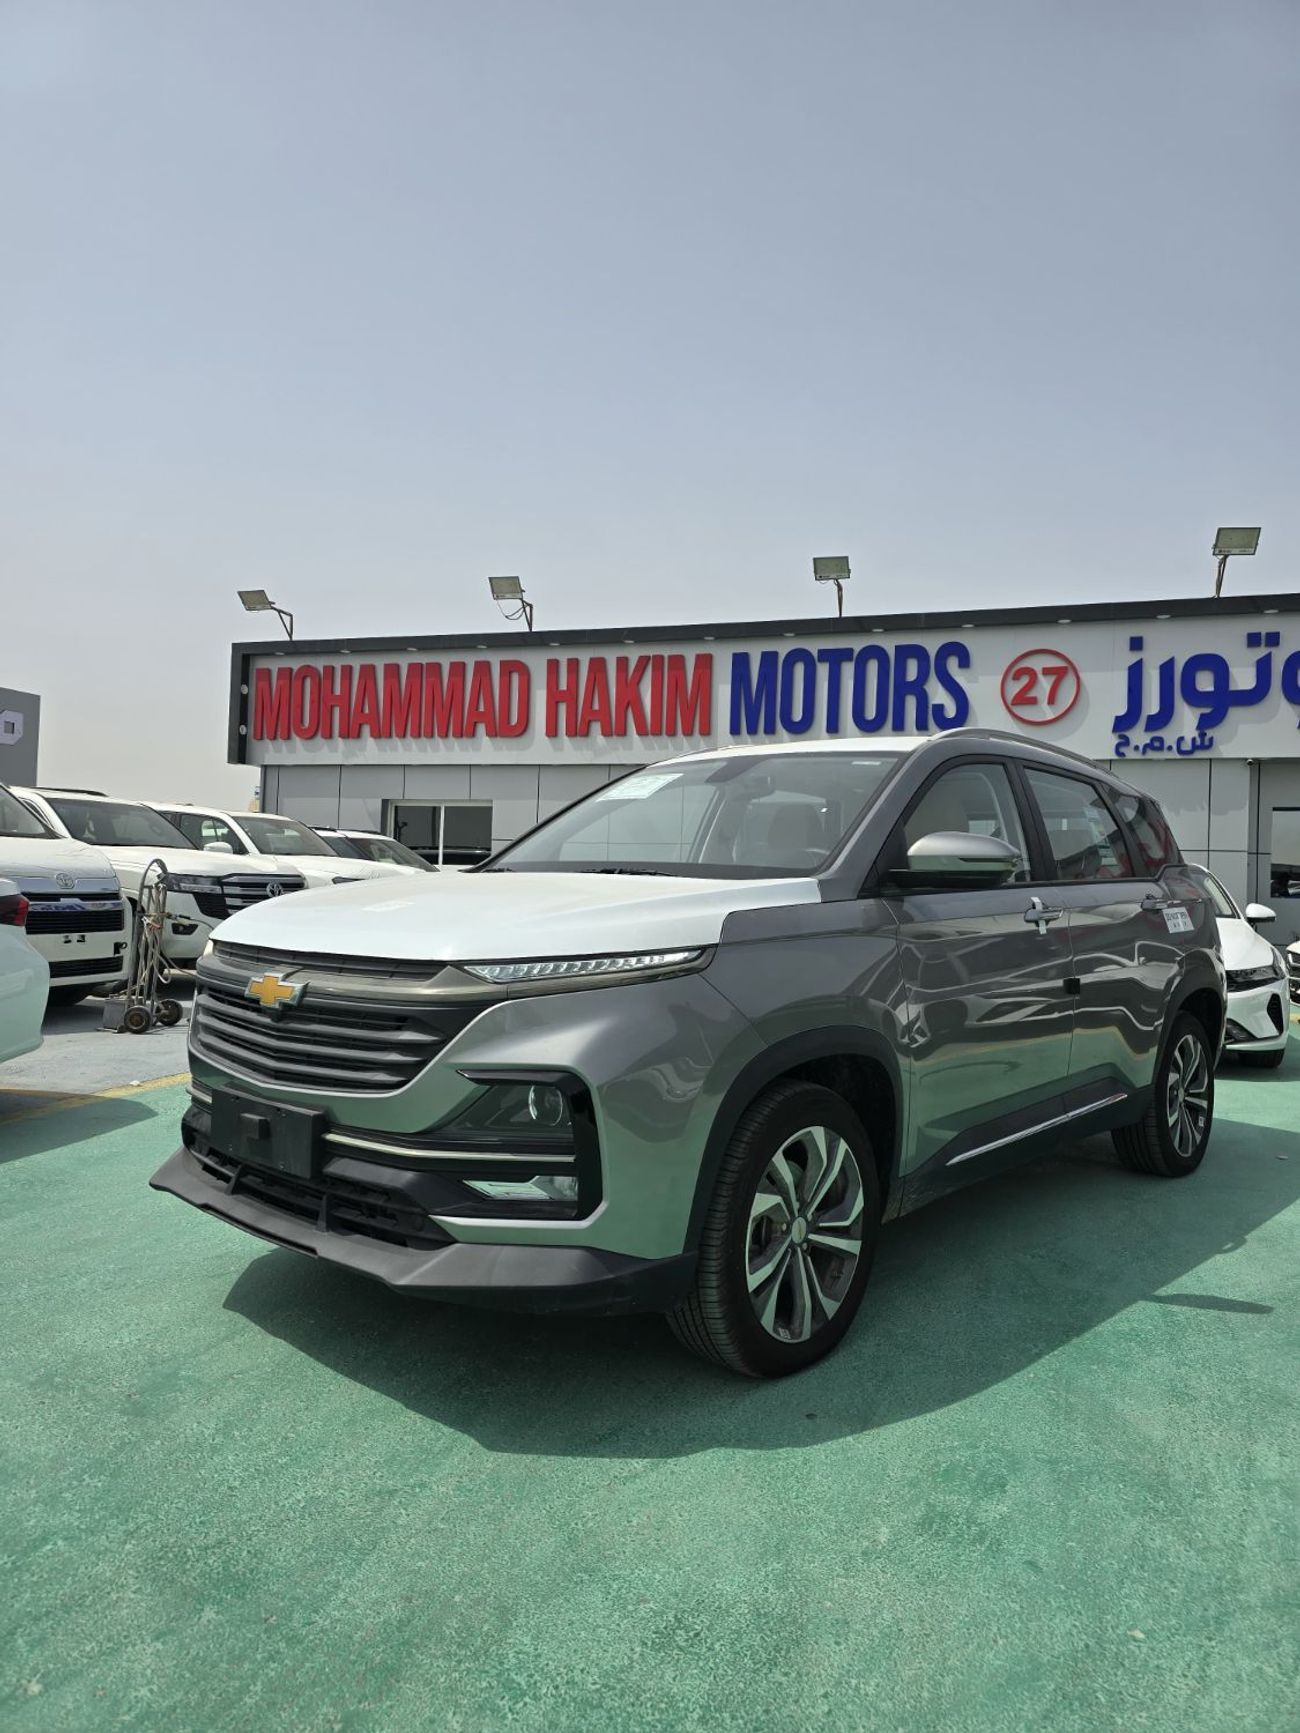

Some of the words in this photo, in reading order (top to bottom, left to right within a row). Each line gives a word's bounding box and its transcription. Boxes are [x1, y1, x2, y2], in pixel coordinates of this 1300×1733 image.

[253, 660, 531, 740] MOHAMMAD
[545, 653, 713, 738] HAKIM
[729, 641, 971, 736] MOTORS
[1010, 665, 1069, 706] 27
